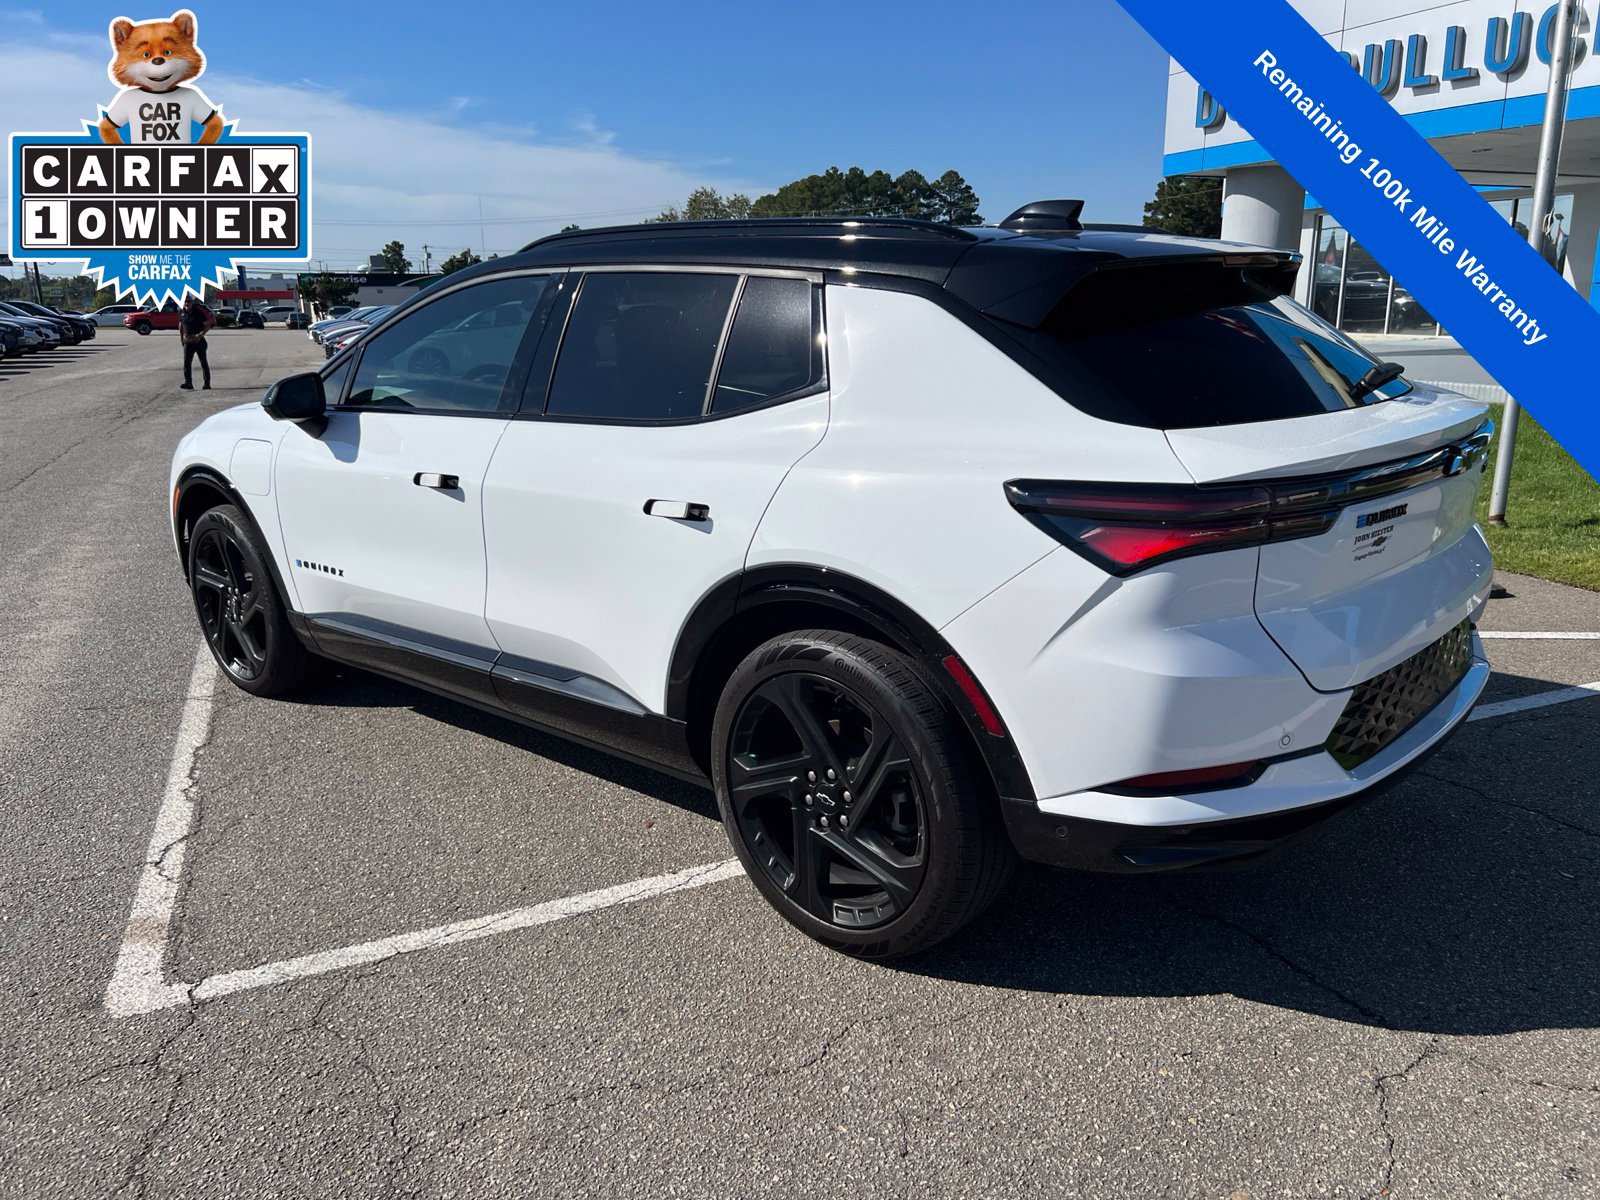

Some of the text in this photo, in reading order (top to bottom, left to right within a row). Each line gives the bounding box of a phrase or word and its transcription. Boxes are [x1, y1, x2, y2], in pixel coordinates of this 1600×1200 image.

[1337, 1, 1600, 104] ULLUC
[1353, 532, 1371, 546] JOHN
[295, 559, 344, 577] EQUINOX
